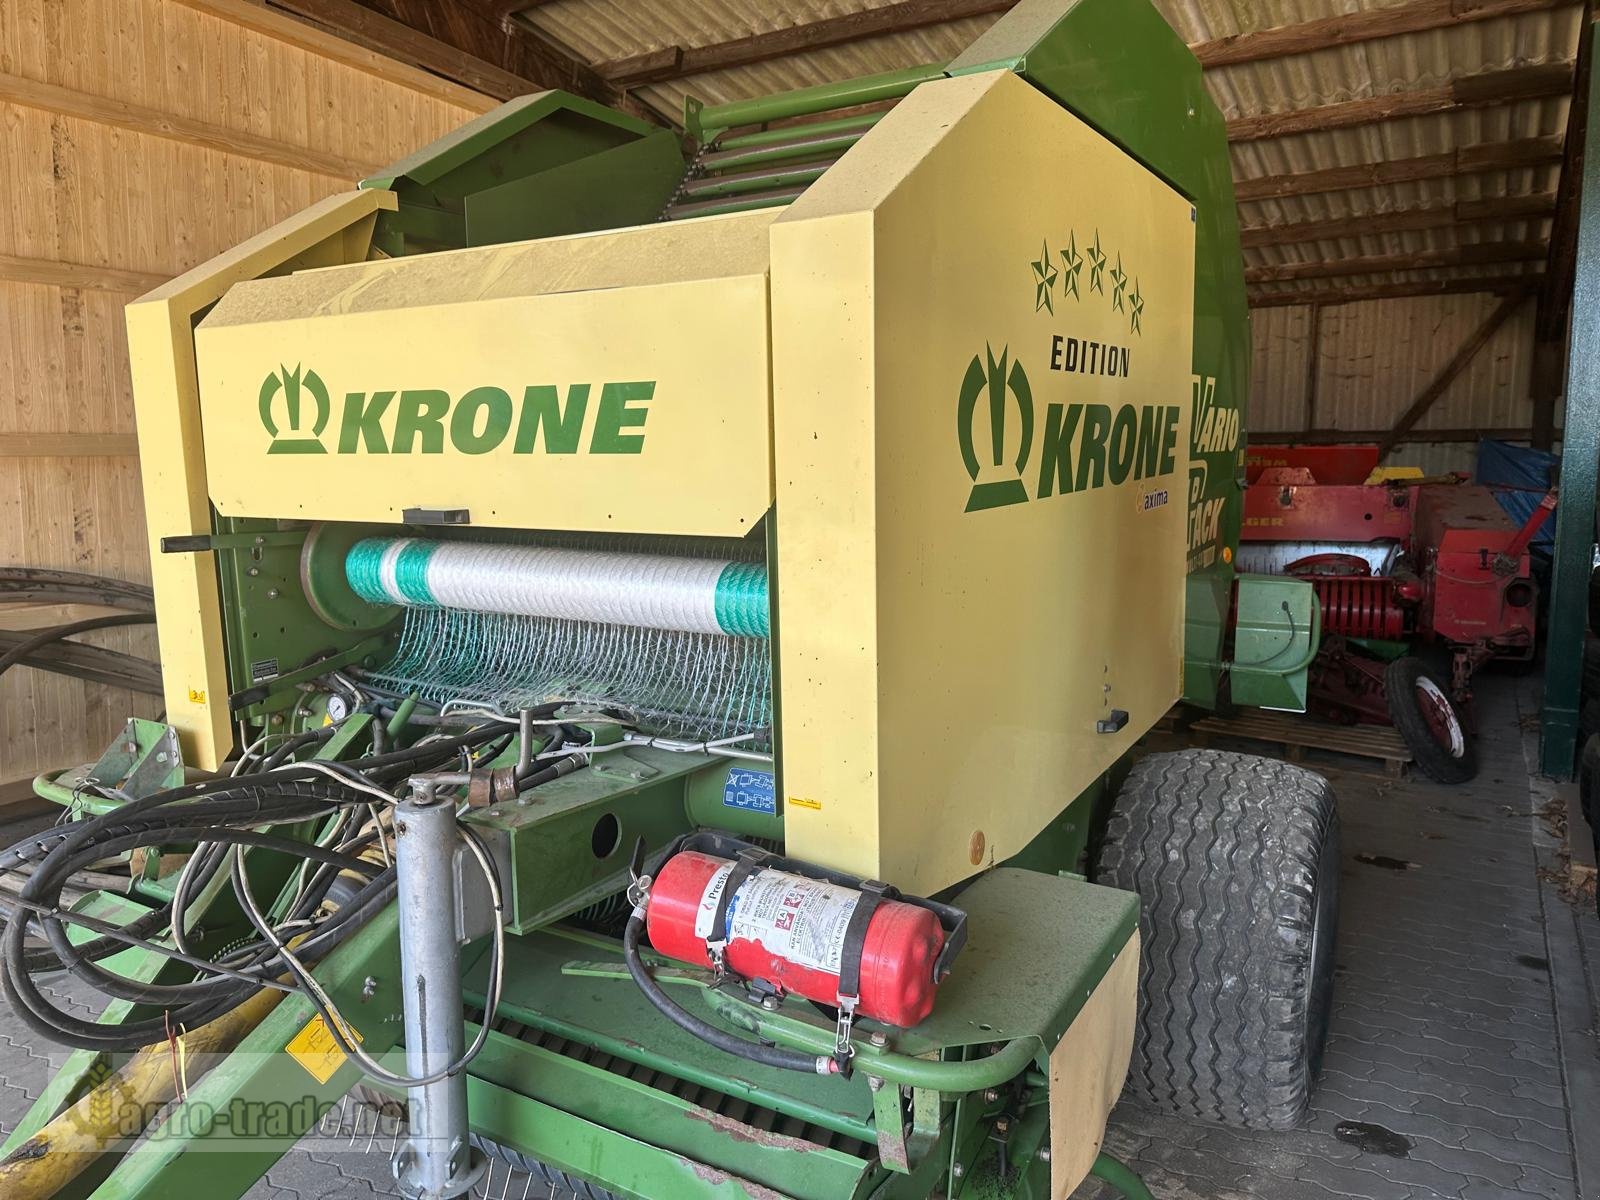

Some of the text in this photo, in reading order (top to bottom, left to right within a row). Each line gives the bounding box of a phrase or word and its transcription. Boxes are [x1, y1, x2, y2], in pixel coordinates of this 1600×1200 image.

[1050, 334, 1131, 378] EDITION
[337, 380, 657, 455] KRONE
[1036, 402, 1181, 500] KRONE
[708, 872, 729, 900] Presto
[779, 910, 786, 918] A
